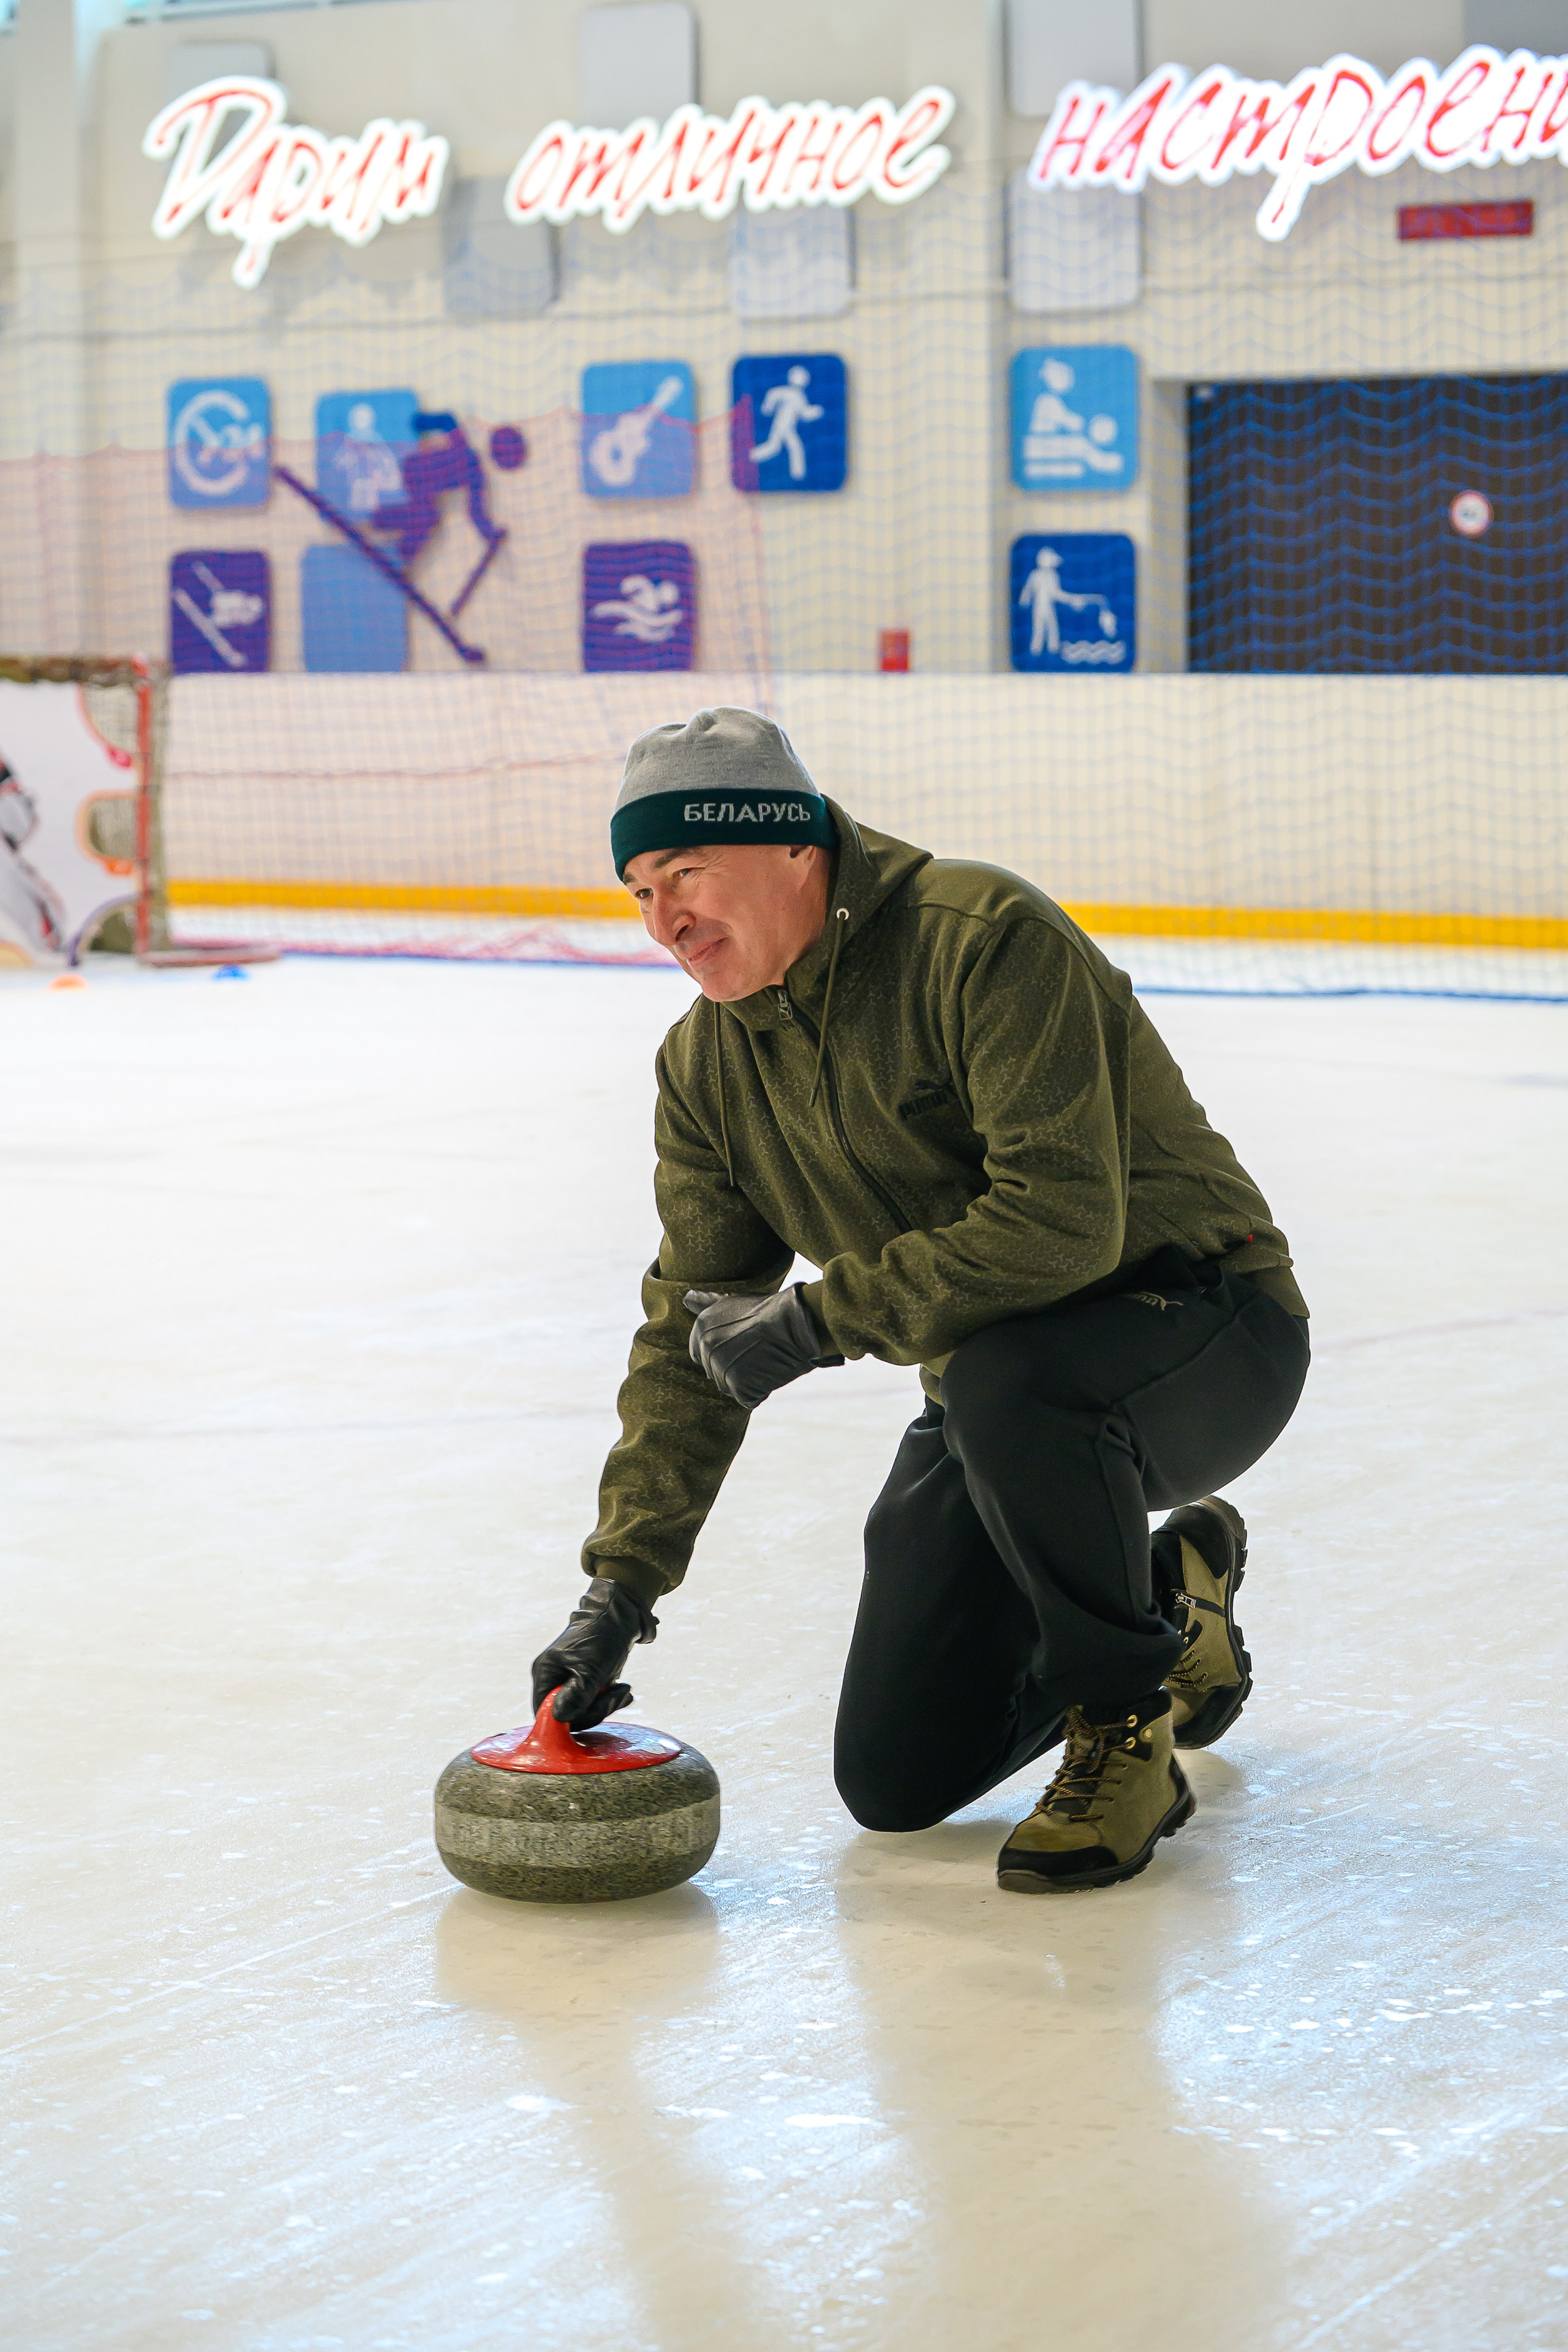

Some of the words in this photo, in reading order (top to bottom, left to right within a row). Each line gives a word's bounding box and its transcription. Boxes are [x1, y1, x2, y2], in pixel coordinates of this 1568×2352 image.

[142, 74, 450, 289] Дарим
[505, 86, 956, 234] отличное
[684, 802, 810, 822] БЕЛАРУСЬ
